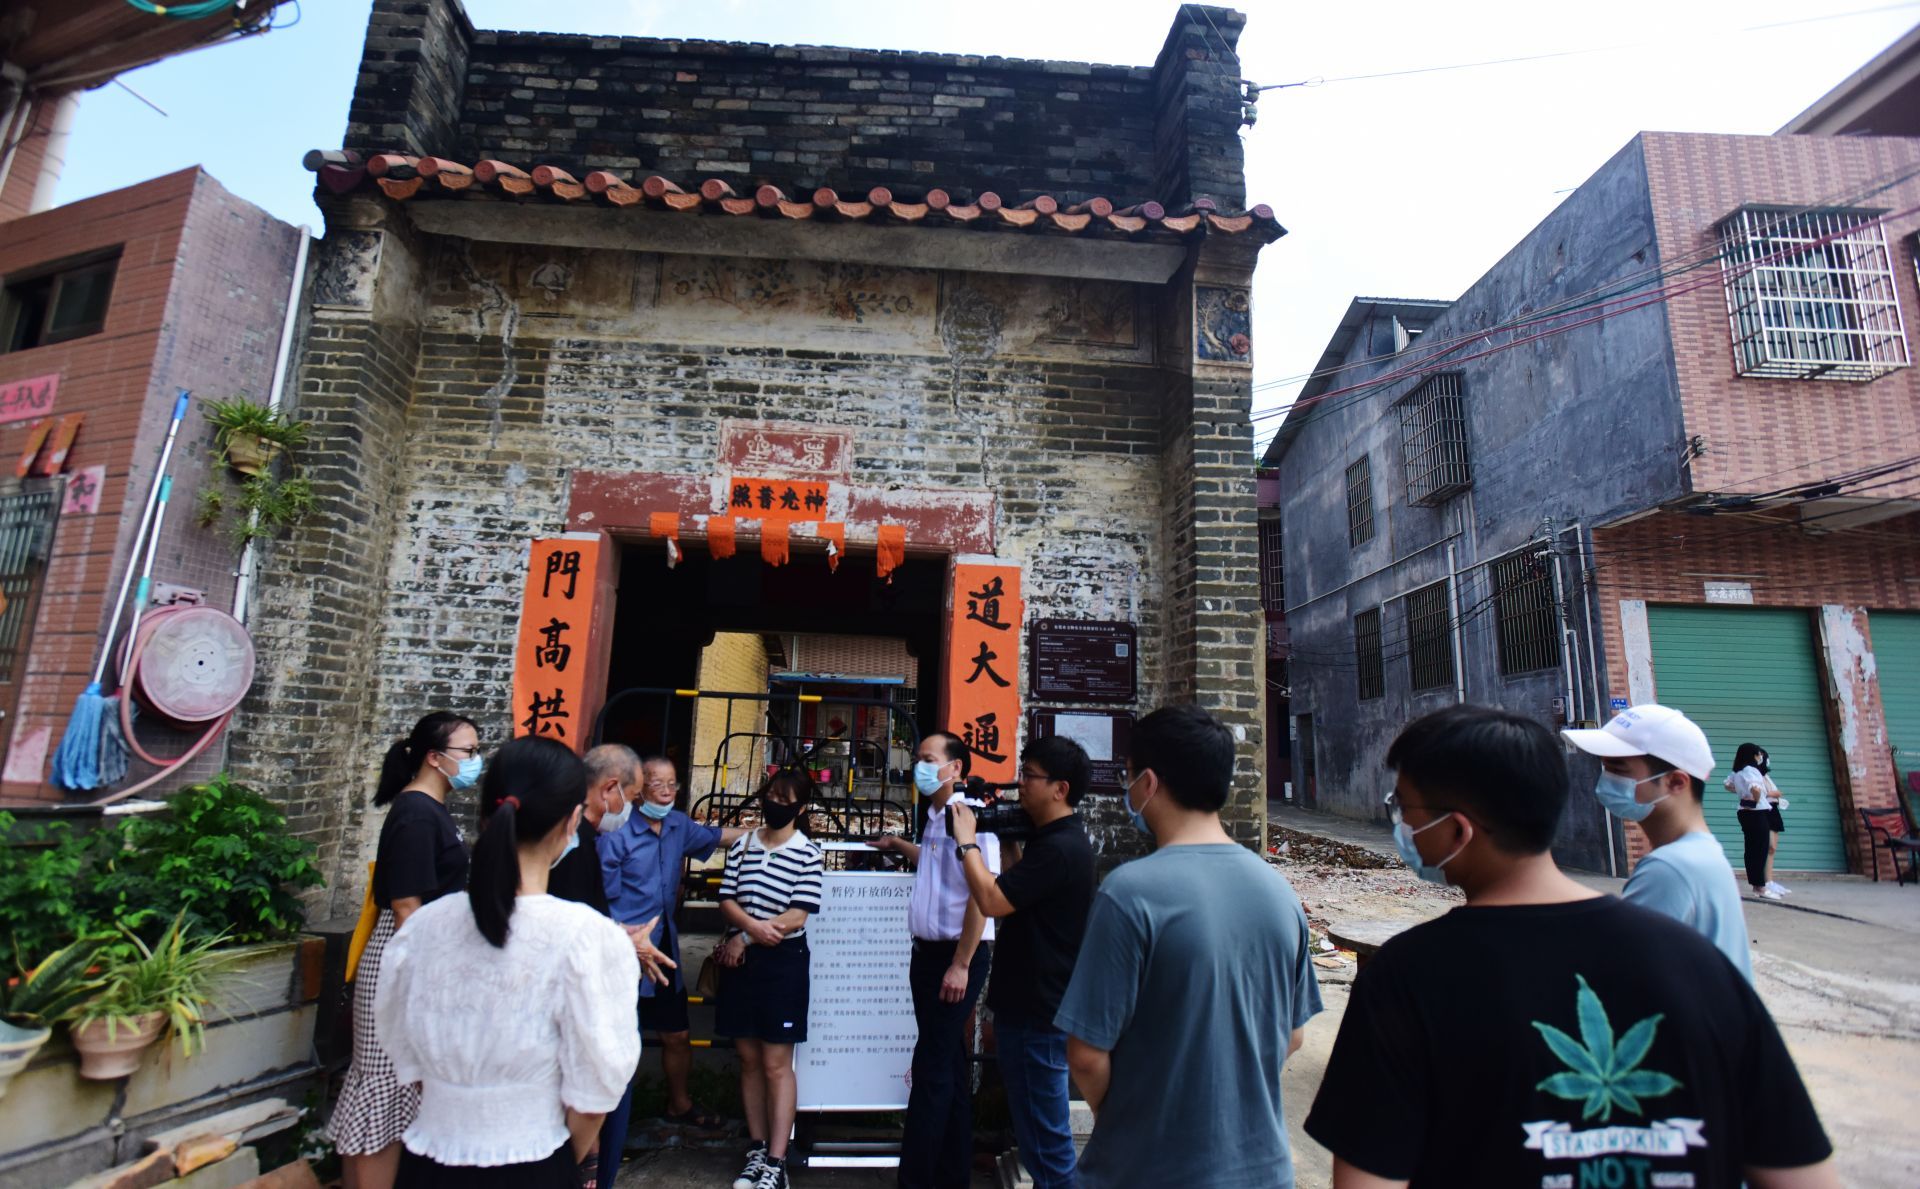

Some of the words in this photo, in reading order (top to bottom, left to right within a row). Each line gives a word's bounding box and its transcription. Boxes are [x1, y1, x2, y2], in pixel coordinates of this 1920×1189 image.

[963, 575, 1012, 764] 道大通
[1581, 1158, 1650, 1189] NOT
